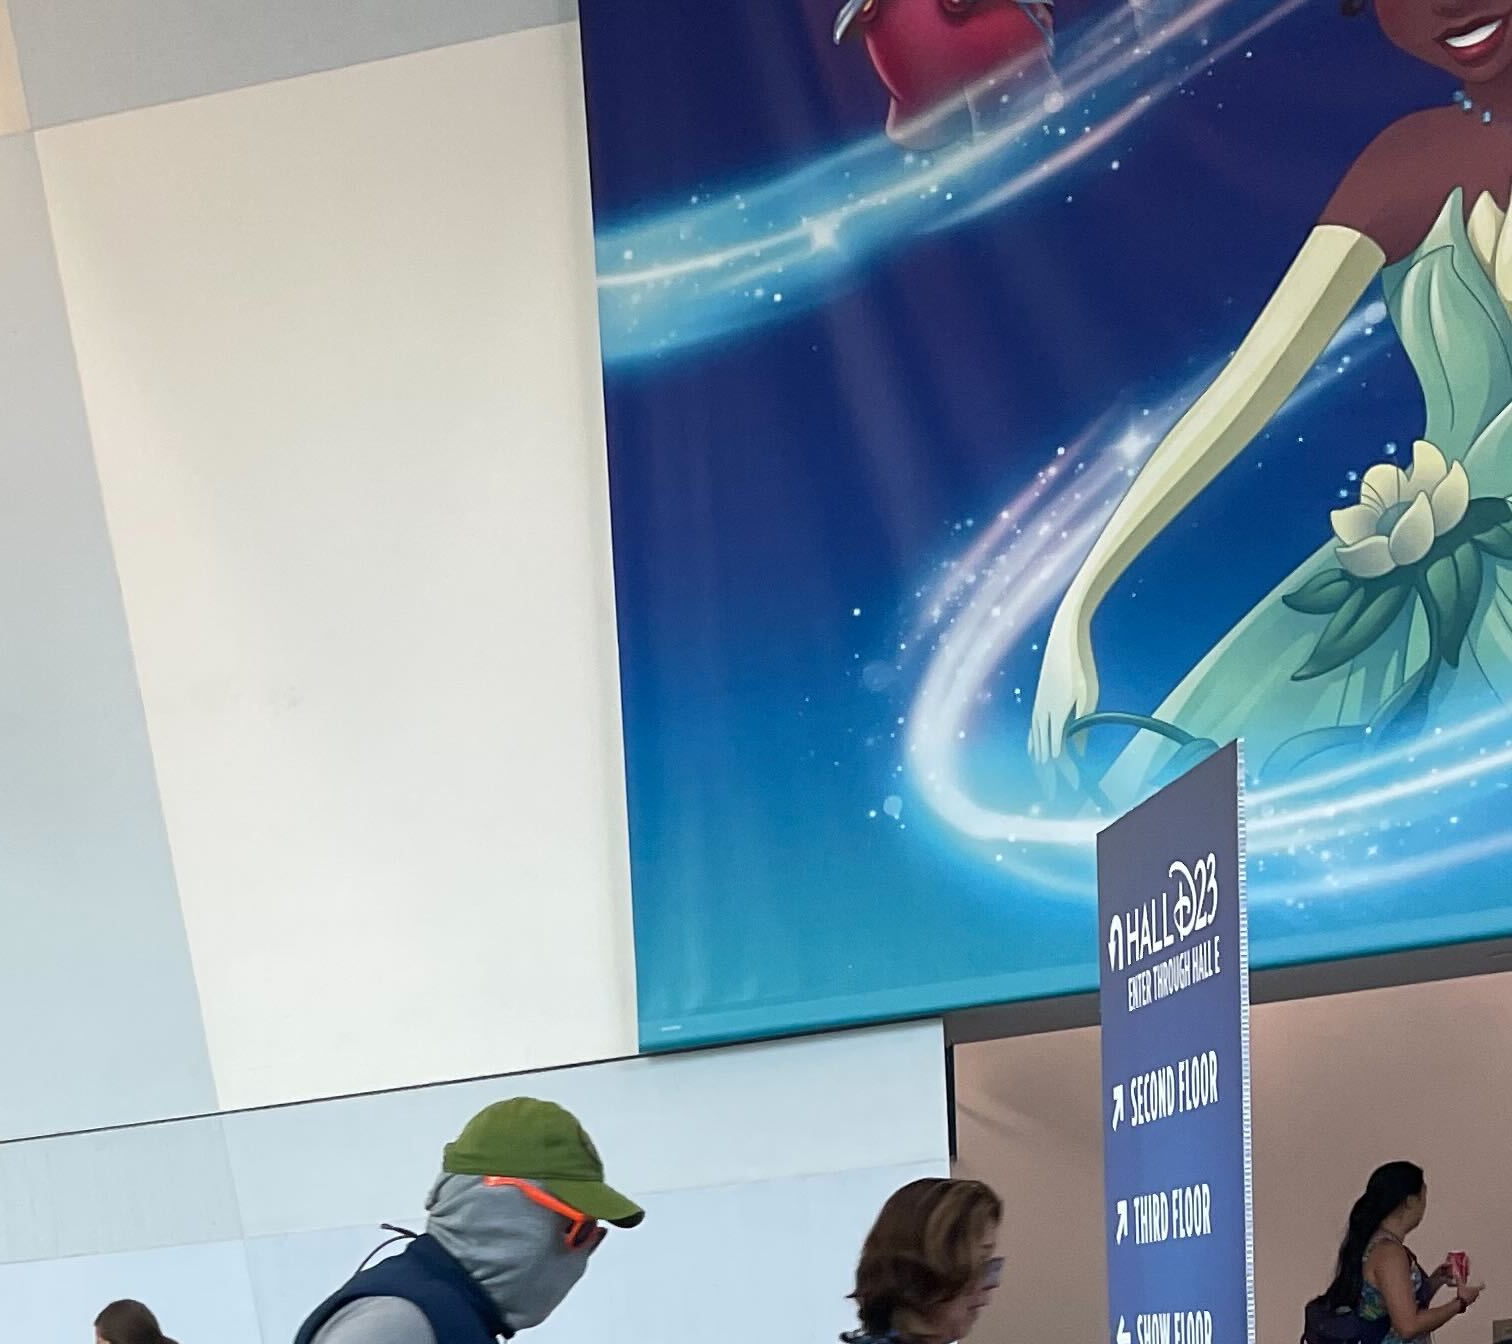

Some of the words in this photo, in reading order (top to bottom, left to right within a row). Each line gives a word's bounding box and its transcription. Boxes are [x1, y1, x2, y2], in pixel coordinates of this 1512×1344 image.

[1126, 892, 1174, 965] HALL
[1168, 852, 1218, 942] D23
[1128, 969, 1152, 1012] ENTER
[1152, 949, 1191, 1000] THROUGH
[1192, 939, 1213, 984] HALL
[1214, 935, 1221, 974] E
[1130, 1065, 1175, 1127] SECOND
[1178, 1050, 1218, 1113] FLOOR
[1133, 1191, 1169, 1245] THIRD
[1172, 1183, 1212, 1240] FLOOR
